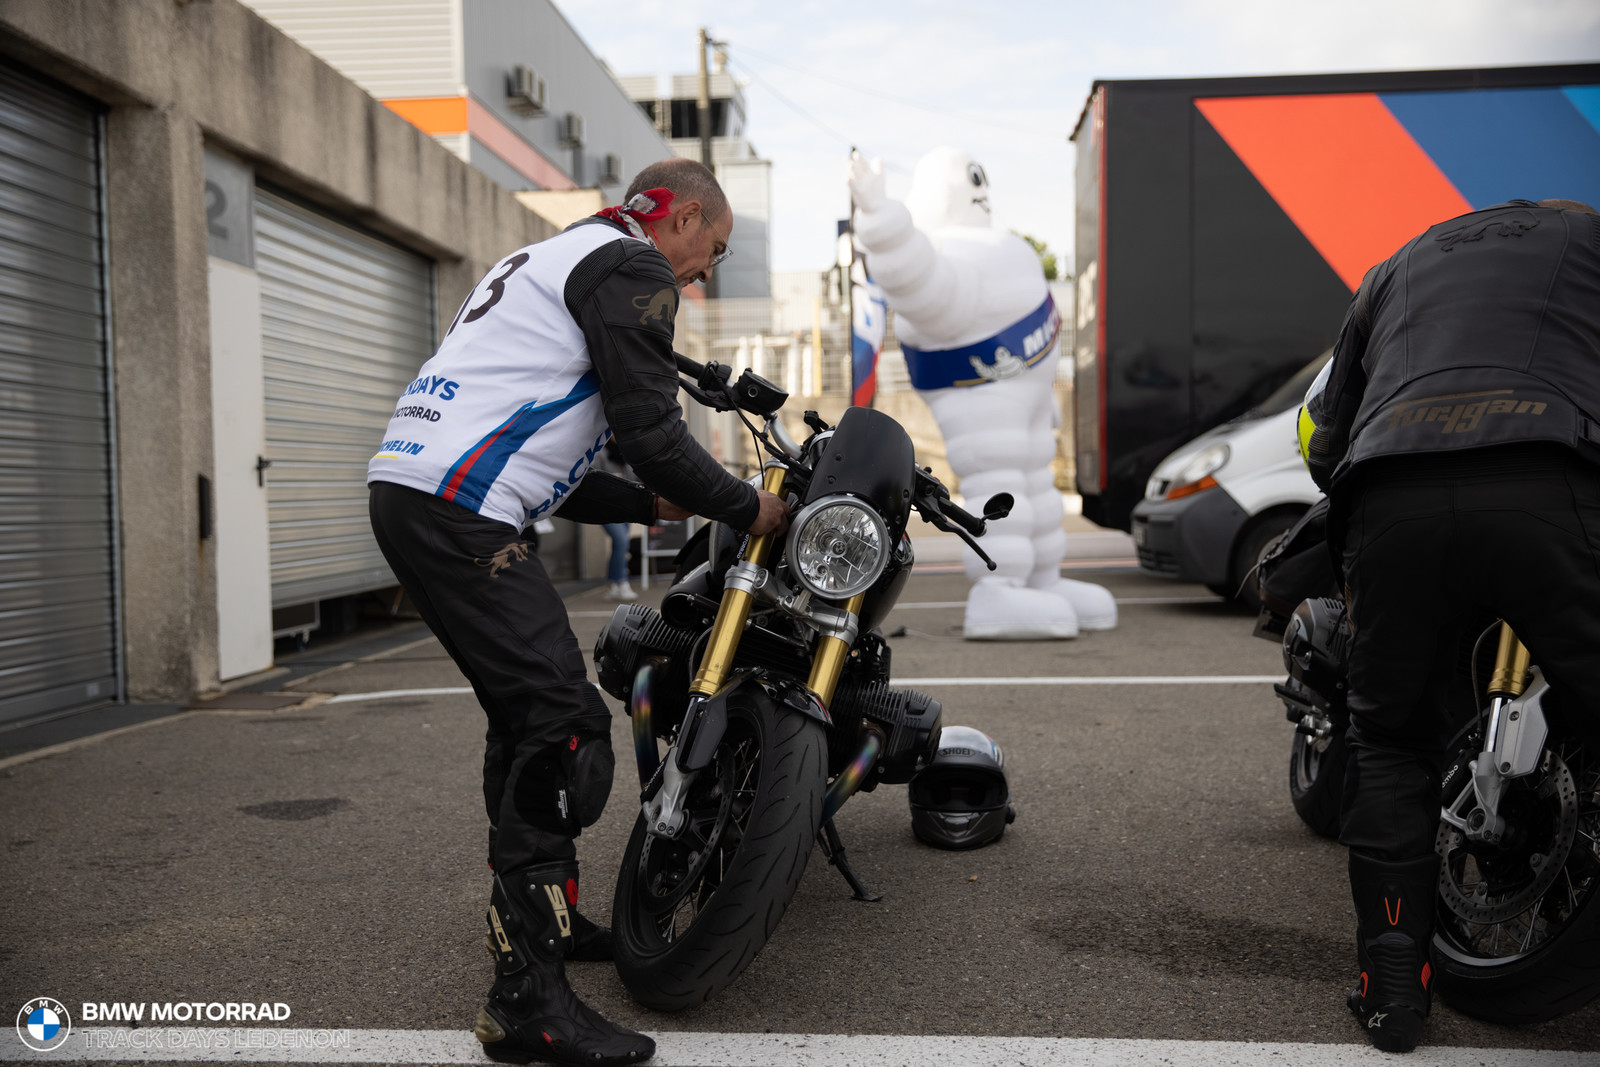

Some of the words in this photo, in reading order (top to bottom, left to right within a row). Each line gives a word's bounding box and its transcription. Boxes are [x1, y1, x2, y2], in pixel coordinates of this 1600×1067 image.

[401, 375, 460, 401] KDAYS
[1387, 389, 1548, 435] furygan
[379, 440, 426, 456] CHELIN
[521, 427, 613, 525] RACK
[736, 533, 750, 559] OTORRAD
[942, 747, 972, 756] SHOEI
[1441, 764, 1459, 789] embo
[543, 884, 571, 938] SIDI
[489, 905, 512, 952] SIDI
